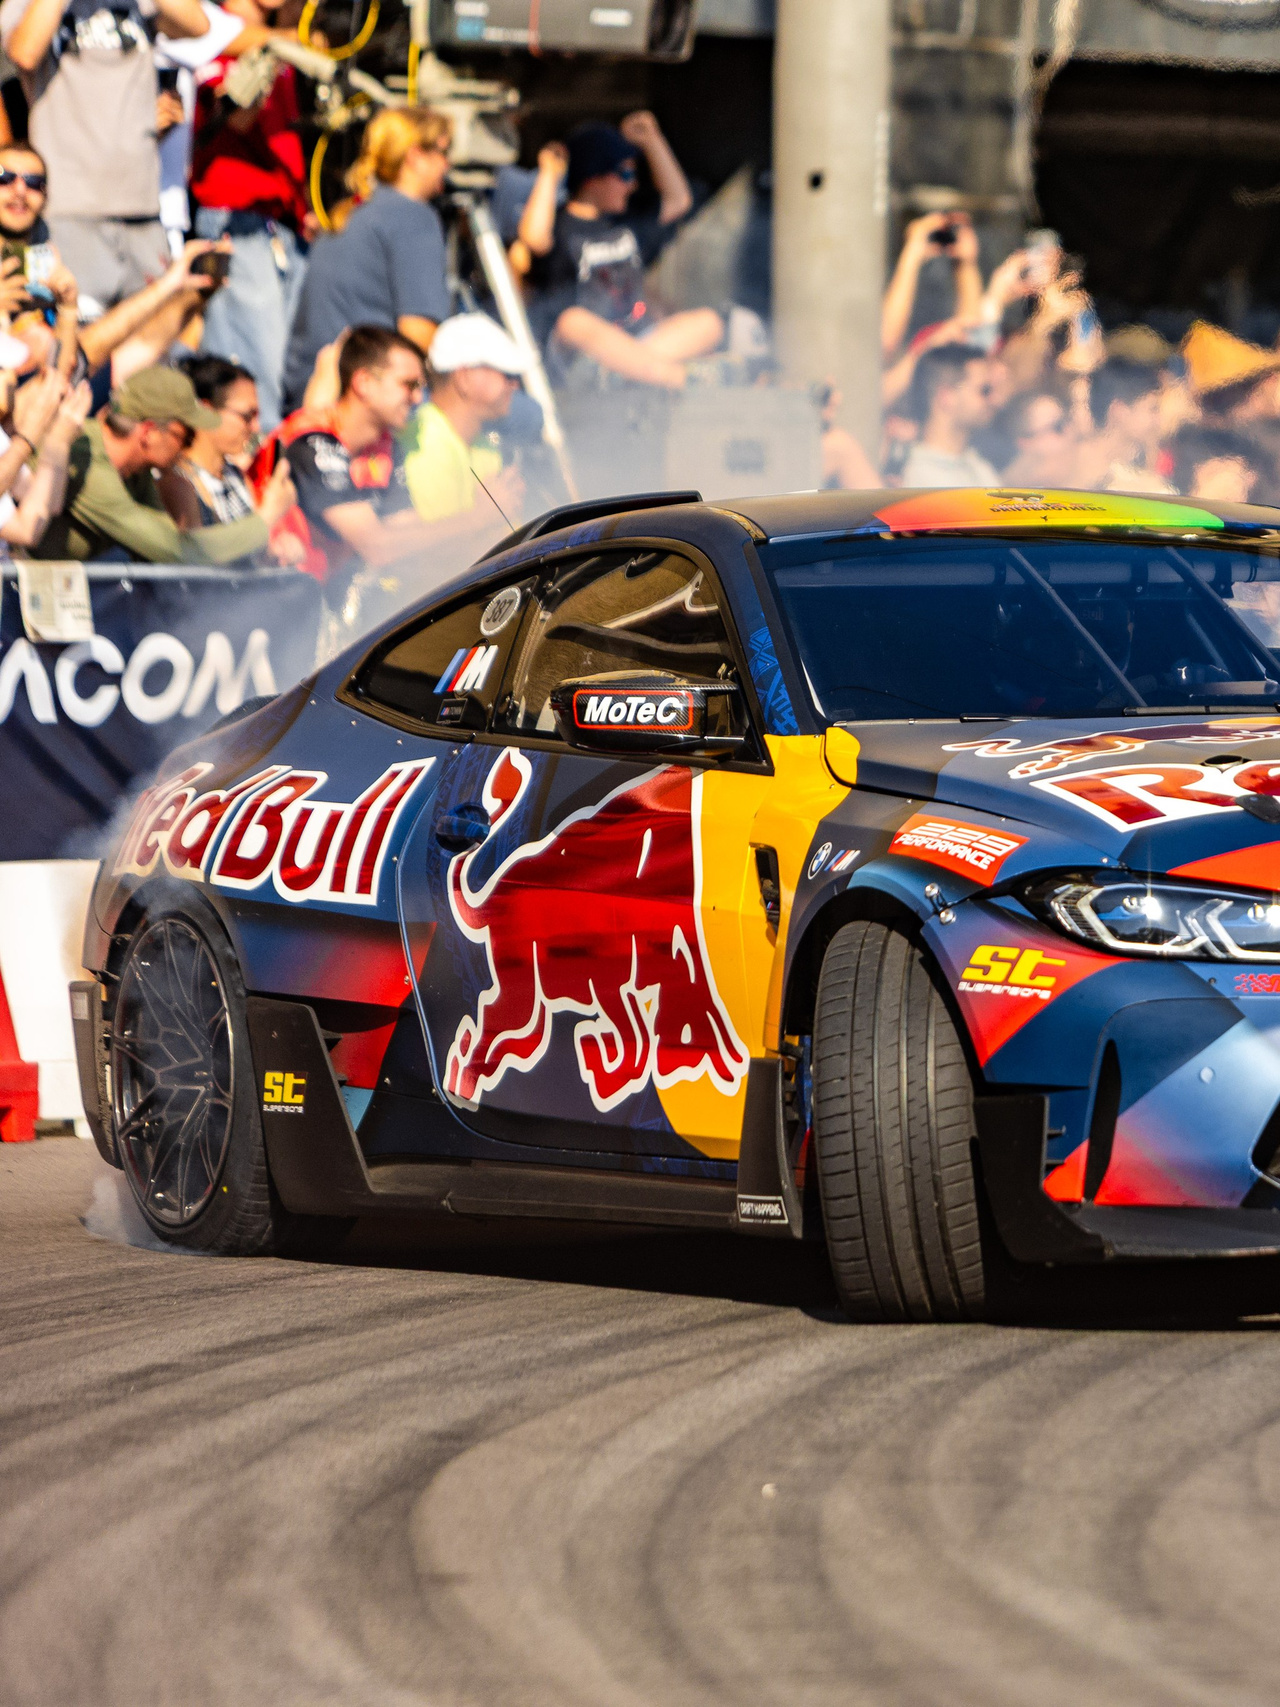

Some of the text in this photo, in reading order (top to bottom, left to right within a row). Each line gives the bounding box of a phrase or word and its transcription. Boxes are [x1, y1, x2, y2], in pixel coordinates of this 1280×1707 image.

[584, 696, 680, 724] MoTeC
[210, 756, 436, 906] Bull
[894, 833, 996, 871] PERFORMANCE
